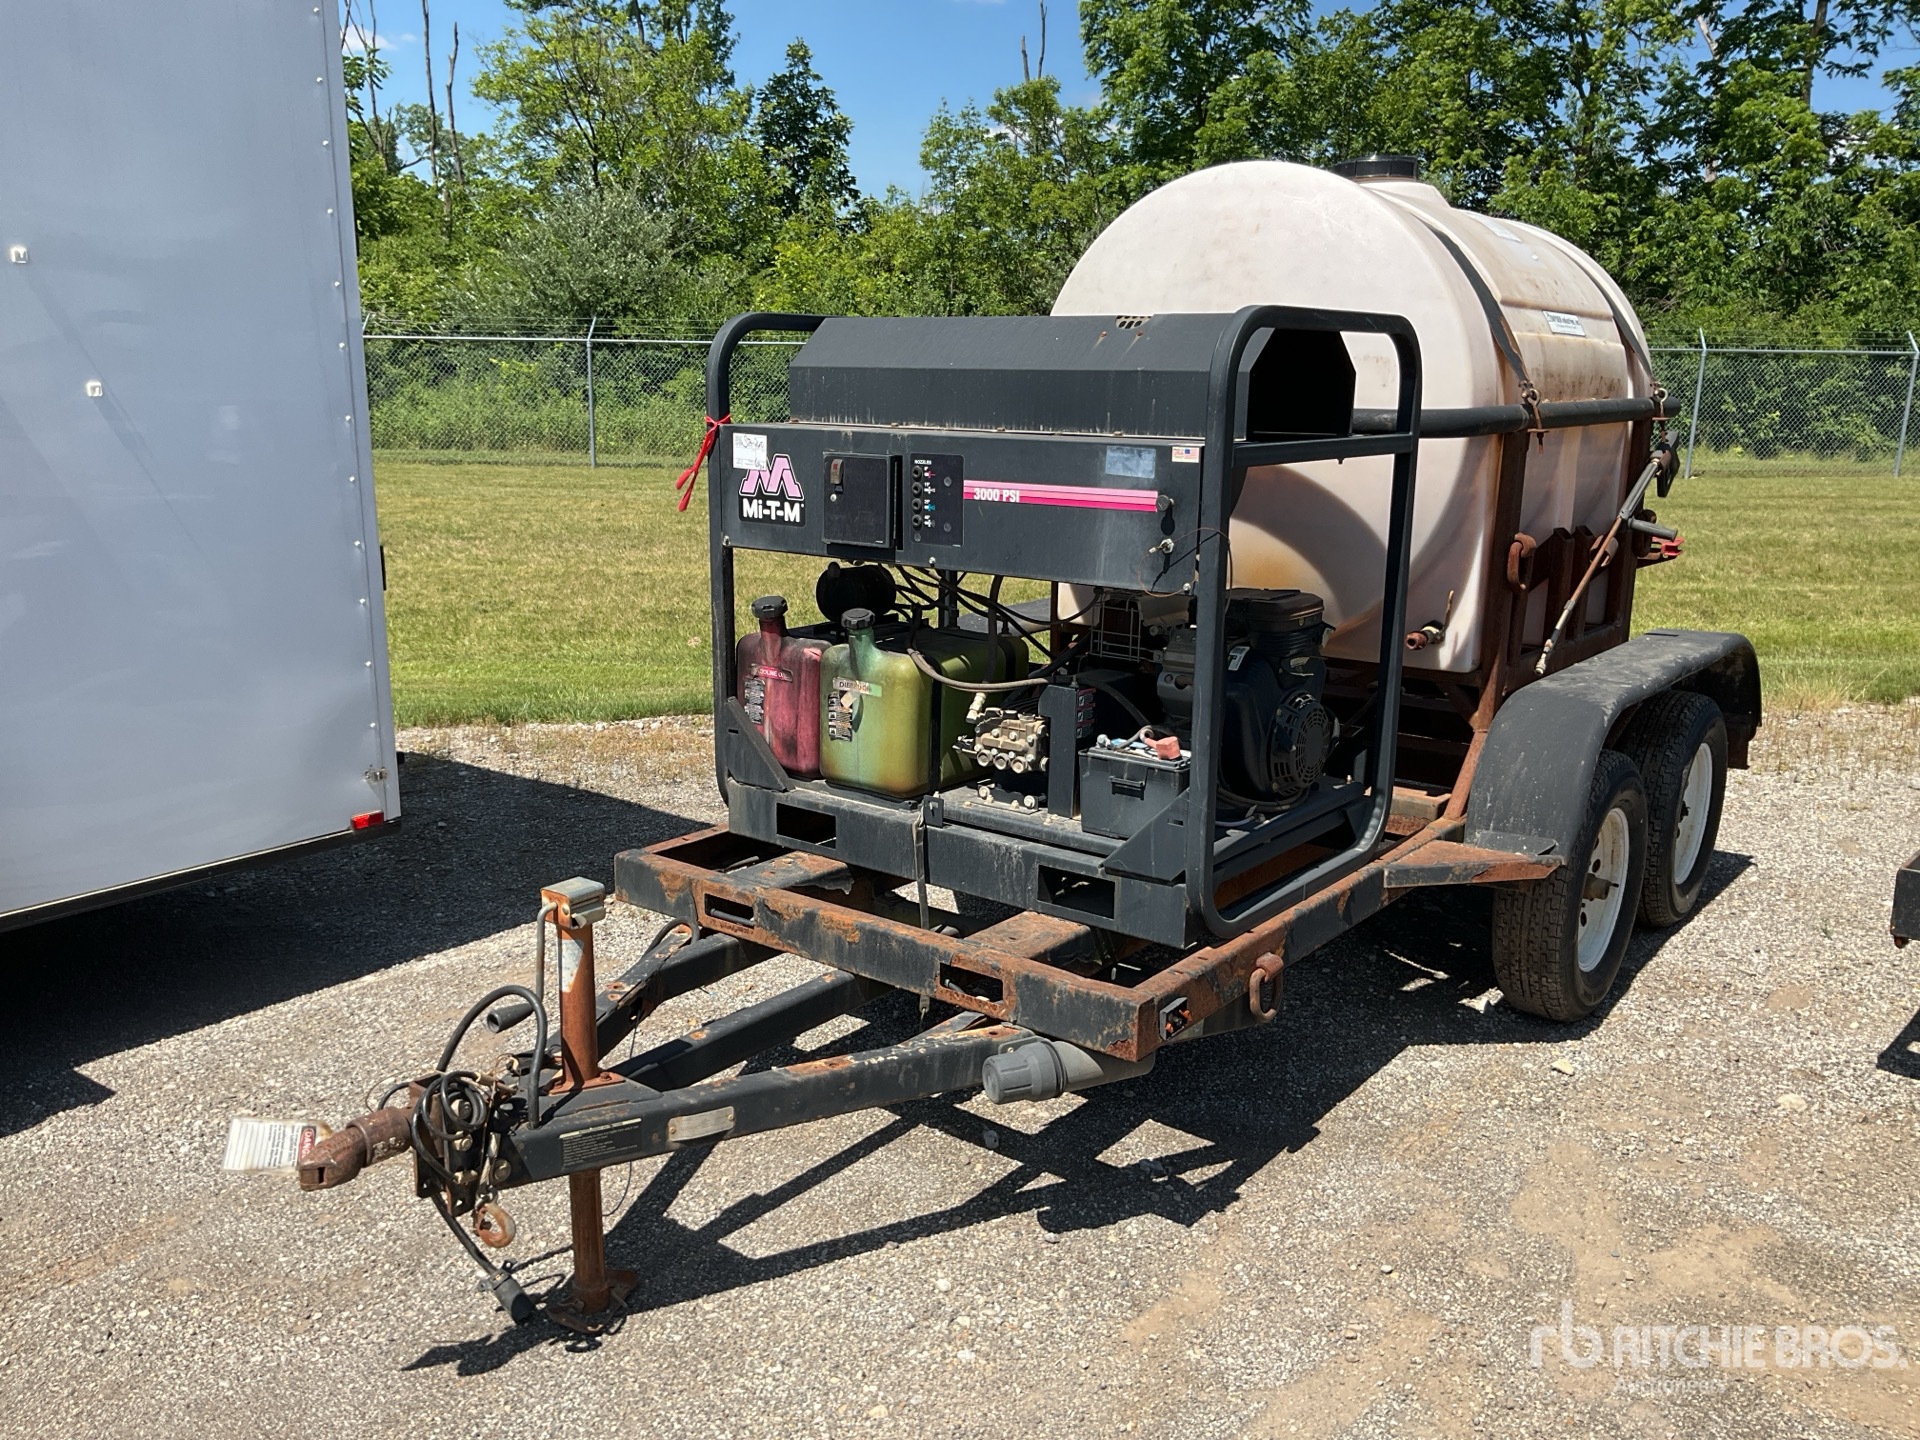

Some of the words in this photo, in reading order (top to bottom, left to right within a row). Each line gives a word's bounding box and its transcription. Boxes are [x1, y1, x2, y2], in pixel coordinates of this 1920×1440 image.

[973, 487, 1000, 502] 3000
[1002, 489, 1020, 503] PSI
[742, 498, 801, 523] Mi-T-M
[301, 1131, 312, 1159] DANG
